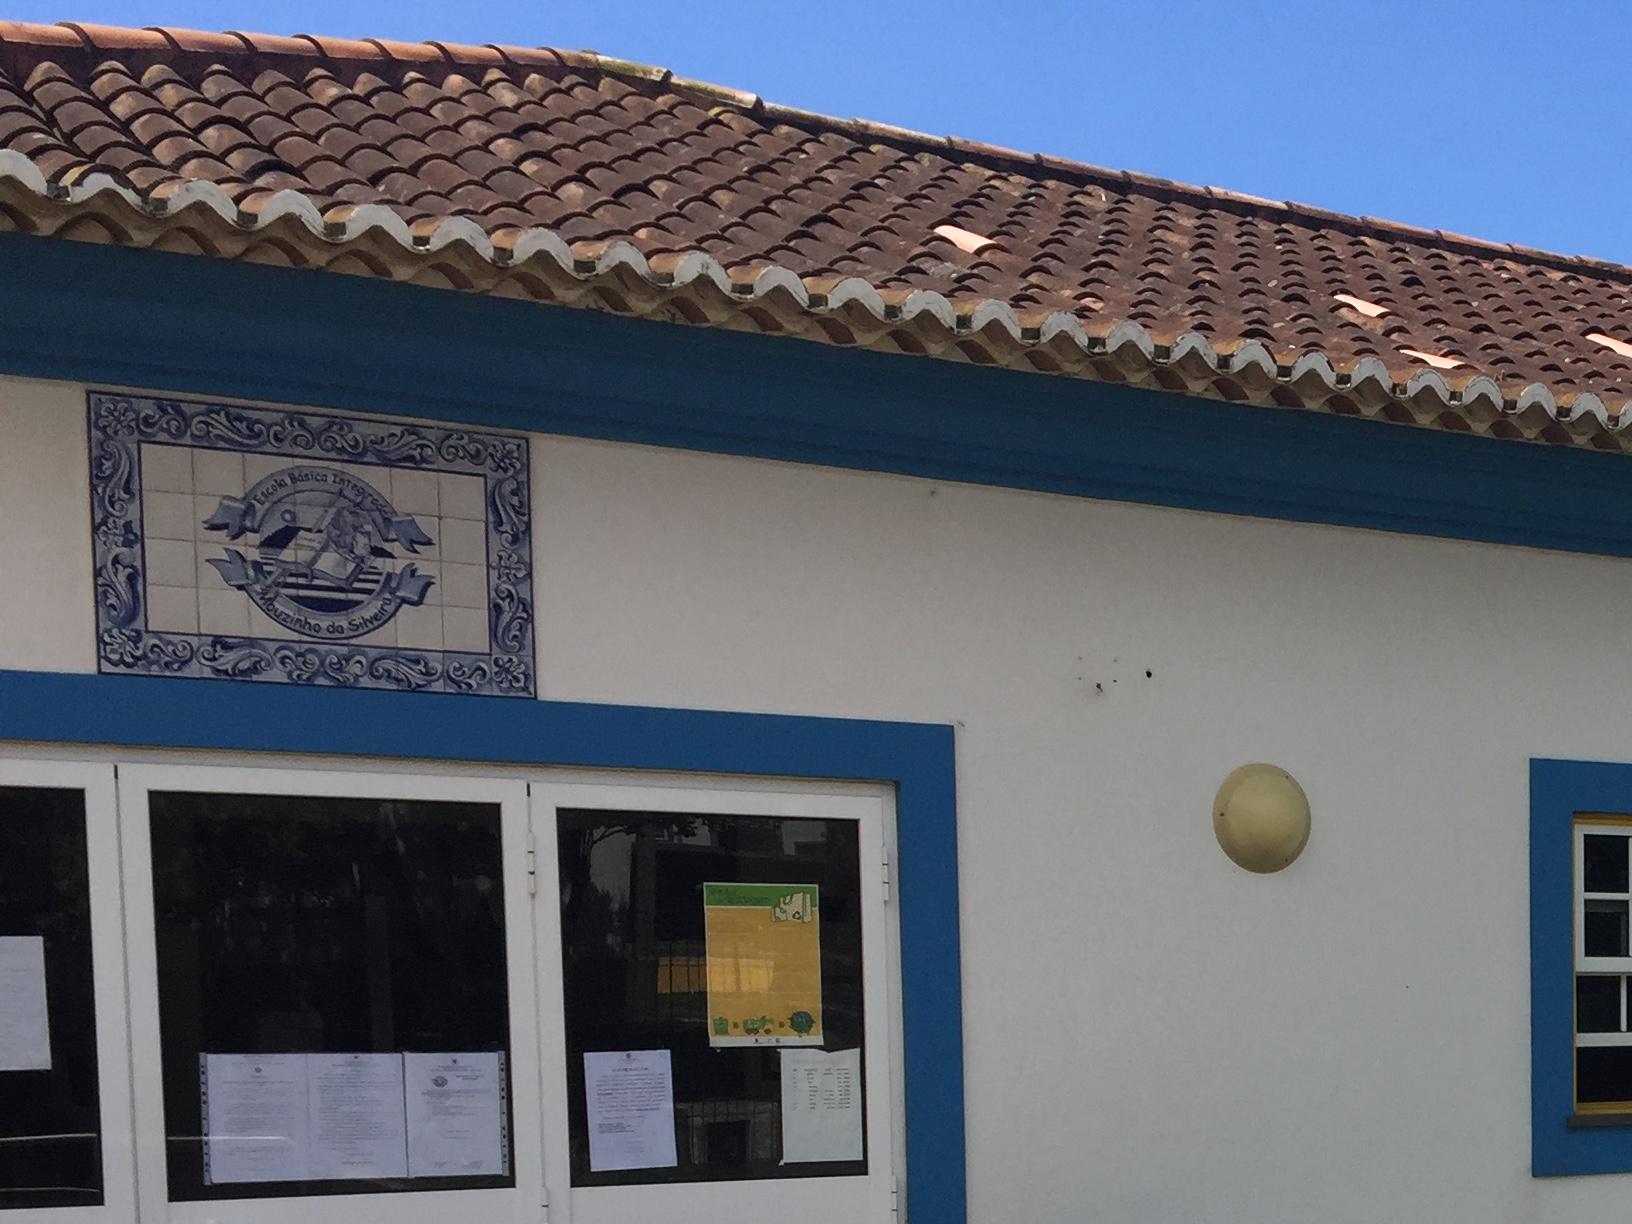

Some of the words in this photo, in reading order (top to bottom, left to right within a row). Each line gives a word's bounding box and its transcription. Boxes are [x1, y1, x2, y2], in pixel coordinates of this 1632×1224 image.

[253, 478, 288, 505] Escola
[326, 622, 344, 634] da
[348, 597, 392, 632] Silveira
